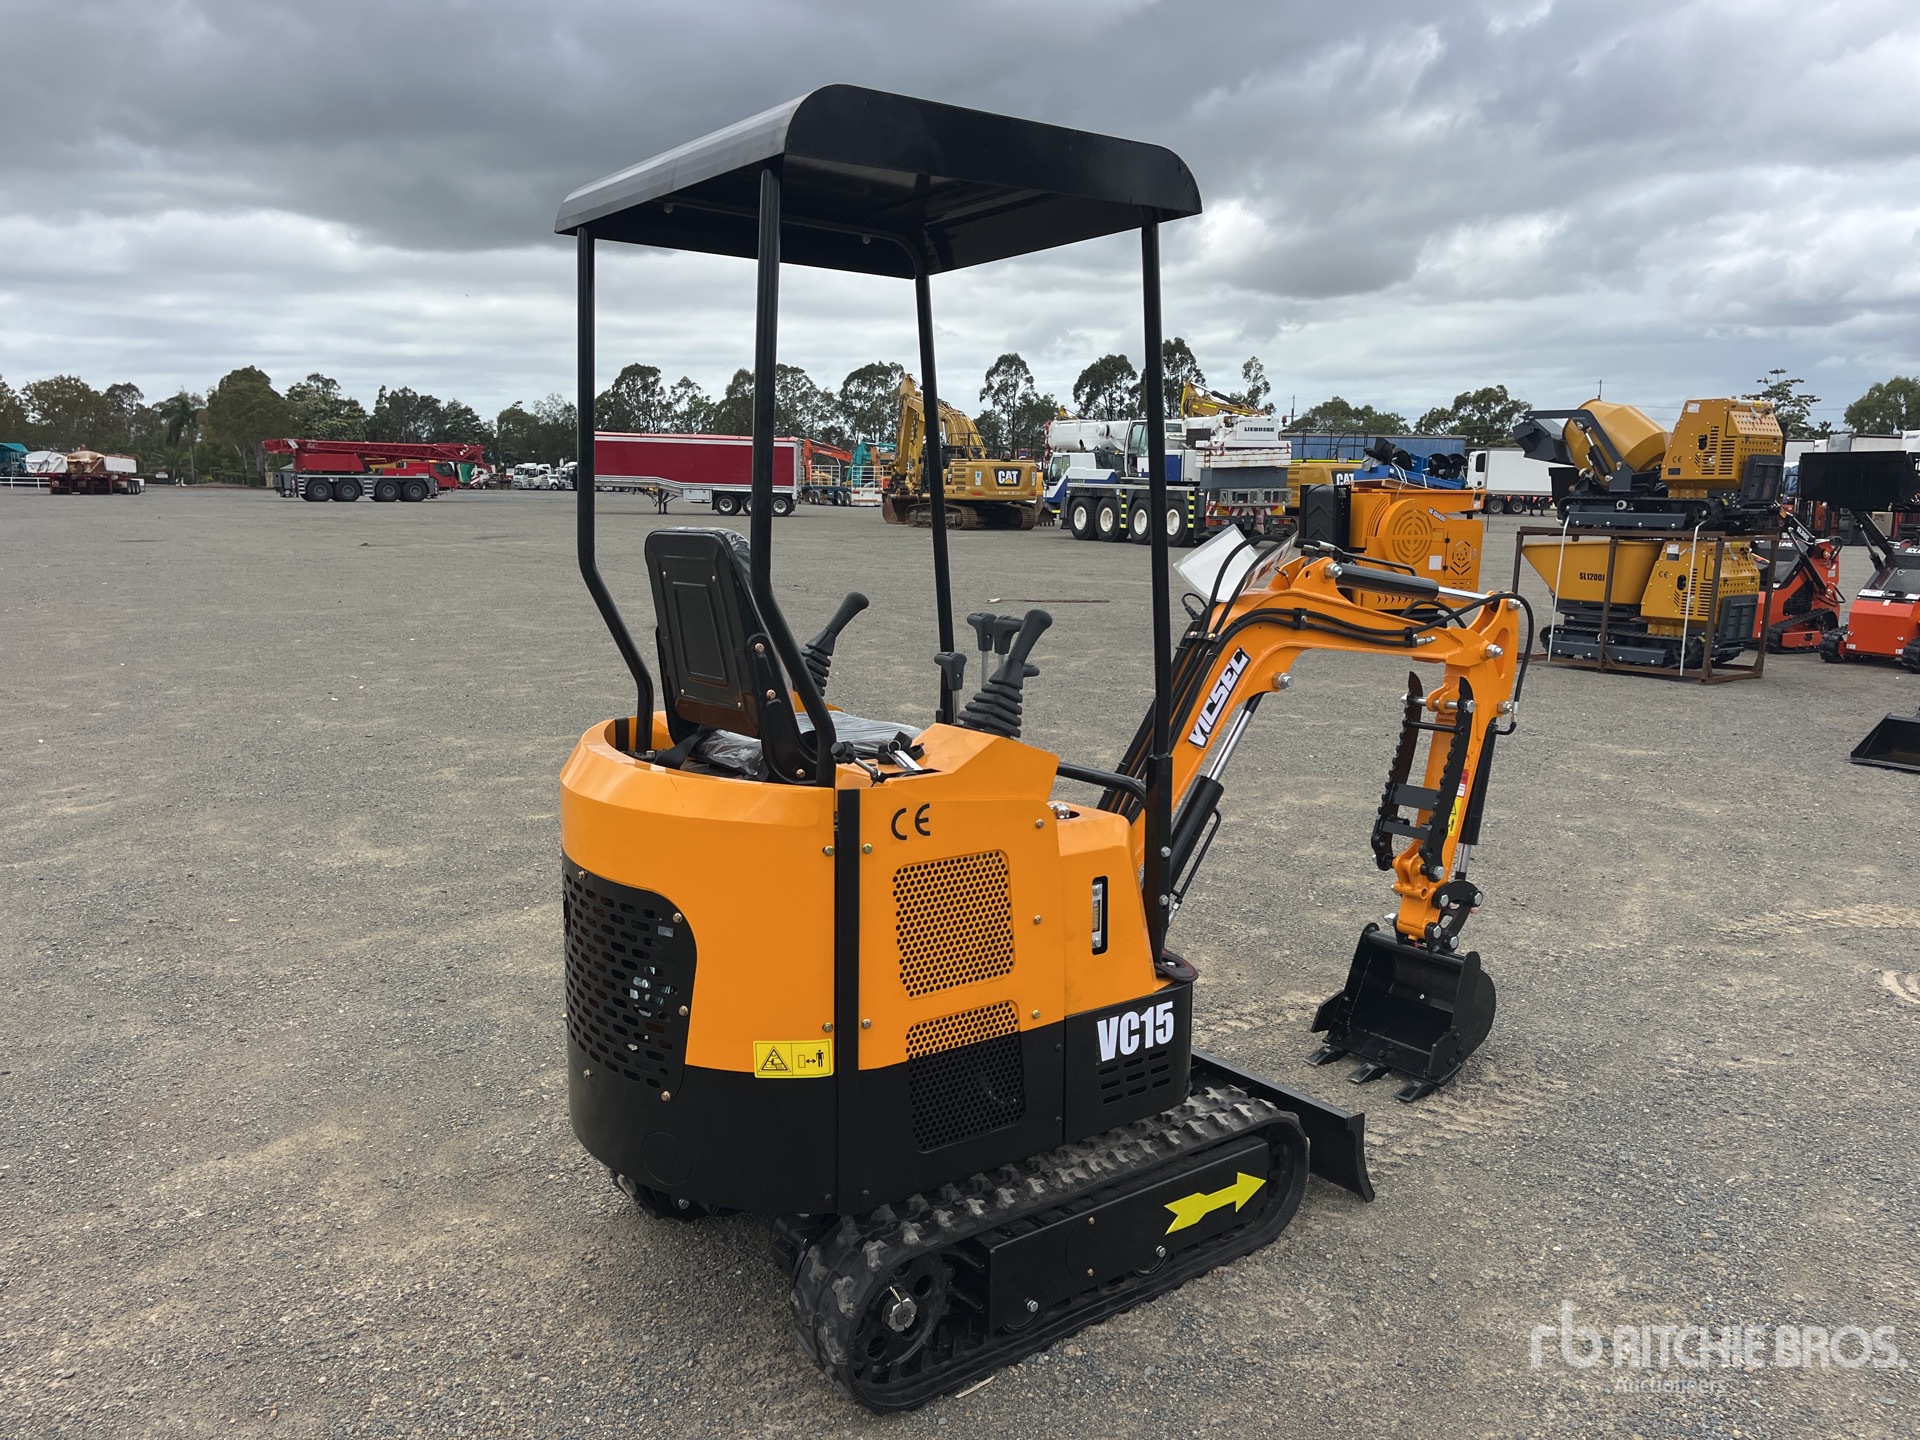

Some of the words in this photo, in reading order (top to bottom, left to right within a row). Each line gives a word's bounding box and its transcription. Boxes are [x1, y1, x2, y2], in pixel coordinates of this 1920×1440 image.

[997, 470, 1019, 484] CAT
[1336, 473, 1354, 485] CAT
[1188, 647, 1252, 748] VICSEC
[1097, 1001, 1174, 1062] VC15
